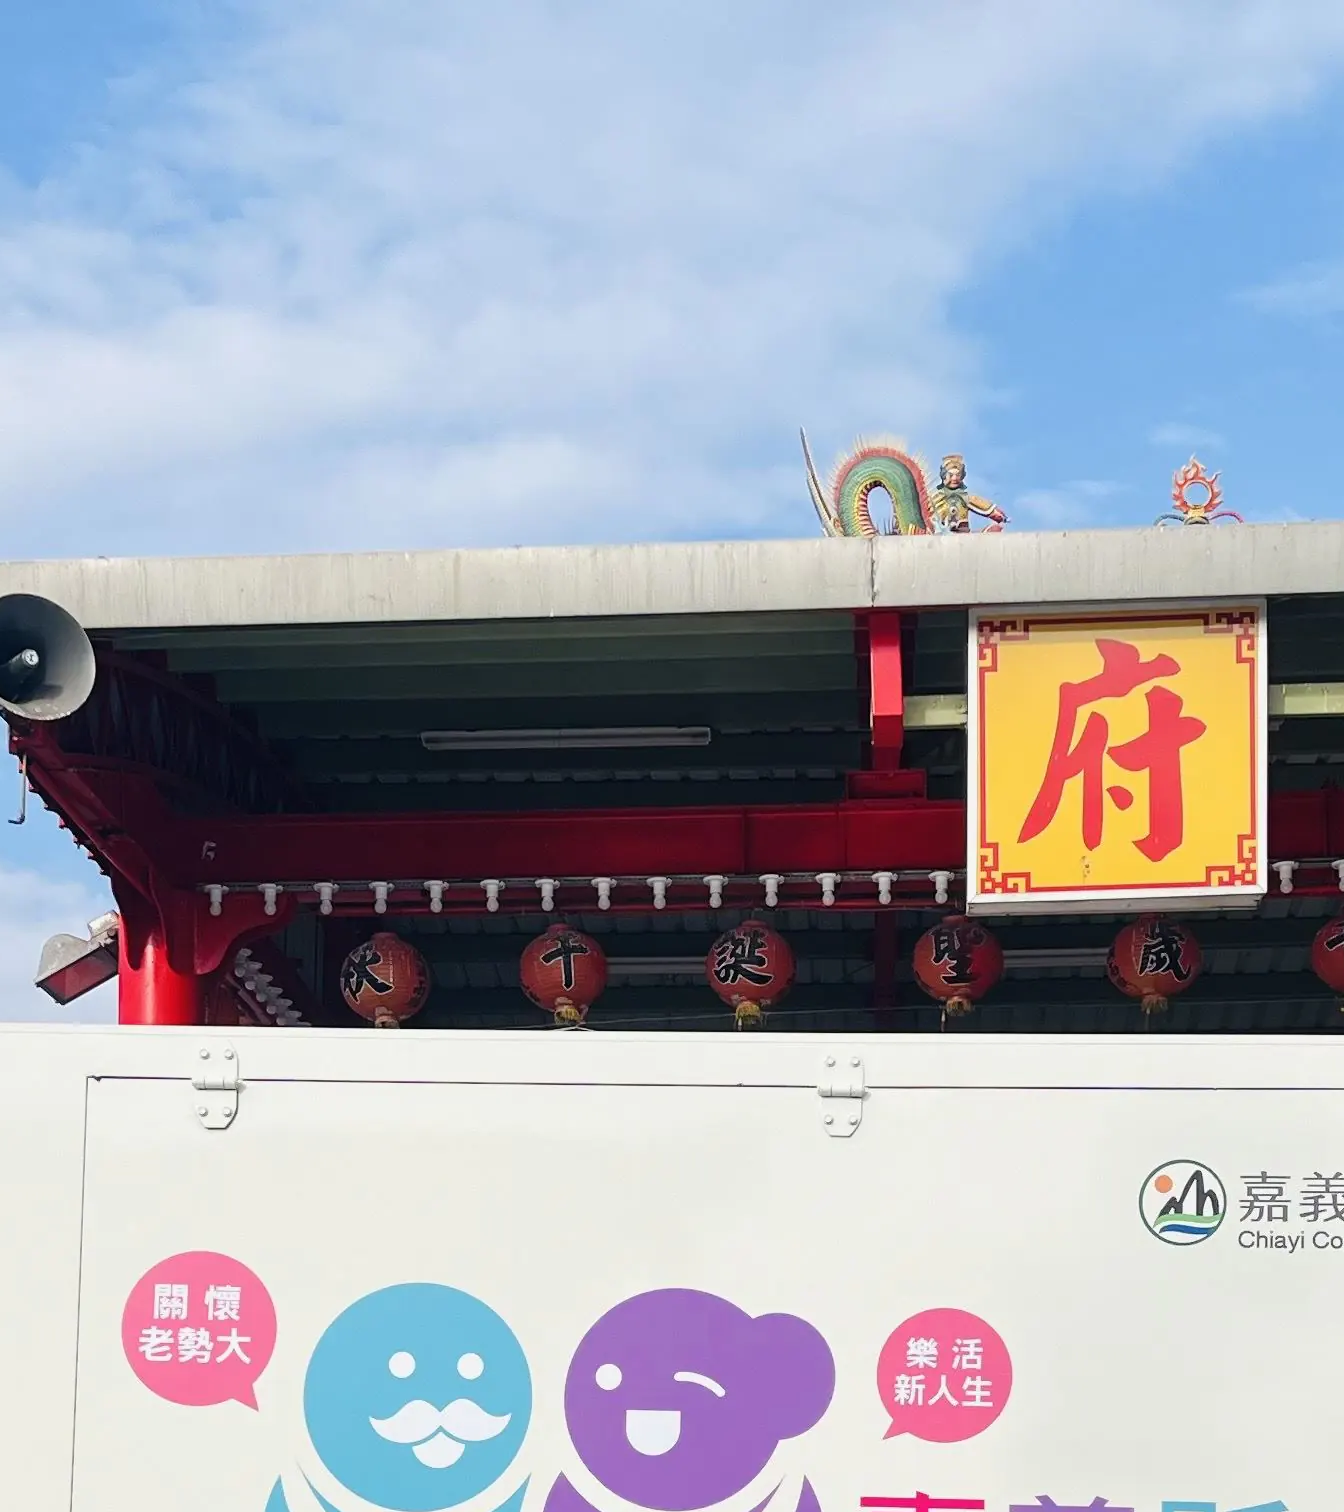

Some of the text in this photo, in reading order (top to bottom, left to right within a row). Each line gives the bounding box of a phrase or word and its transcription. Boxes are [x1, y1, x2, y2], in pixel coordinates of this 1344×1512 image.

[1017, 638, 1207, 863] 府
[540, 931, 587, 991] 千
[1137, 920, 1190, 981] 歲
[1238, 1231, 1306, 1254] Chiayi
[153, 1282, 242, 1323] 關懷
[139, 1326, 253, 1367] 老勢大
[906, 1337, 984, 1371] 樂活
[893, 1373, 994, 1408] 新人生
